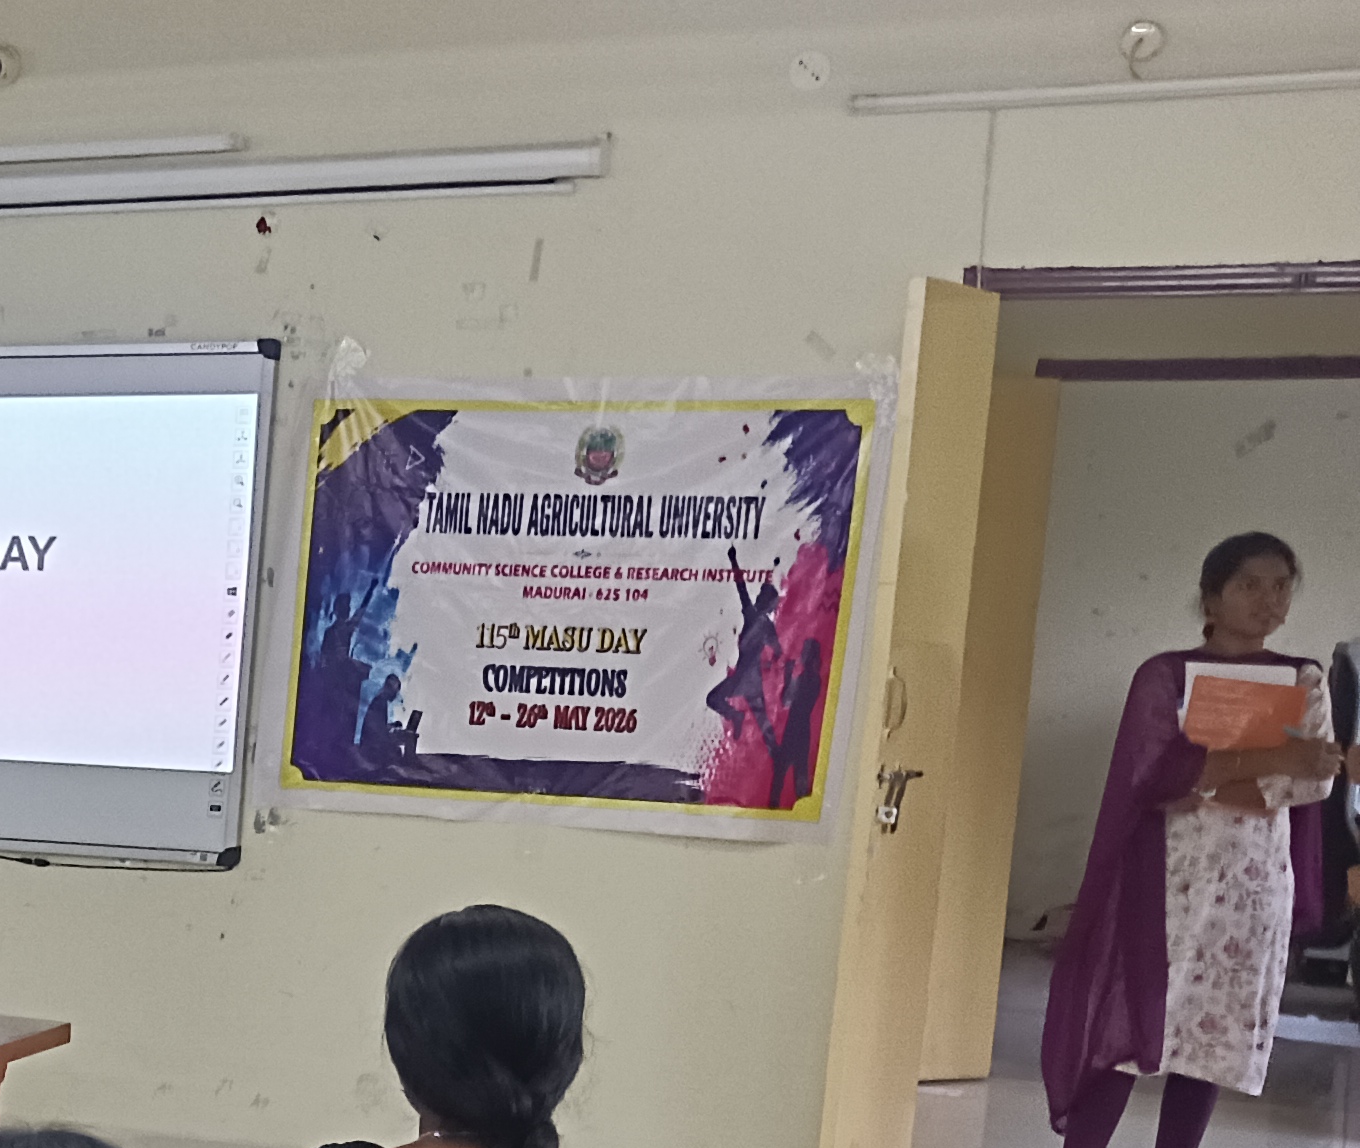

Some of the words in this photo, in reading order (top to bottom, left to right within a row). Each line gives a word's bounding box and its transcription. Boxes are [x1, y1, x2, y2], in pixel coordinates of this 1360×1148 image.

[425, 492, 472, 535] TAMIL
[477, 493, 525, 537] NADU
[527, 494, 653, 538] AGRICULTURAL
[659, 495, 765, 540] UNIVERSITY
[412, 562, 493, 577] COMMUNITY
[494, 563, 547, 579] SCIENCE
[550, 564, 611, 580] COLLEGE
[614, 566, 623, 580] &
[628, 566, 699, 582] RESEARCH
[522, 585, 586, 601] MADURAI
[595, 587, 621, 601] 625
[624, 587, 648, 602] 104
[476, 622, 520, 650] 115th
[523, 624, 593, 652] MASU
[595, 628, 647, 654] DAY
[482, 663, 628, 698] COMPETITIONS
[469, 700, 496, 726] 12th
[516, 703, 548, 729] 26th
[553, 705, 591, 731] MAY
[593, 706, 638, 733] 2026
